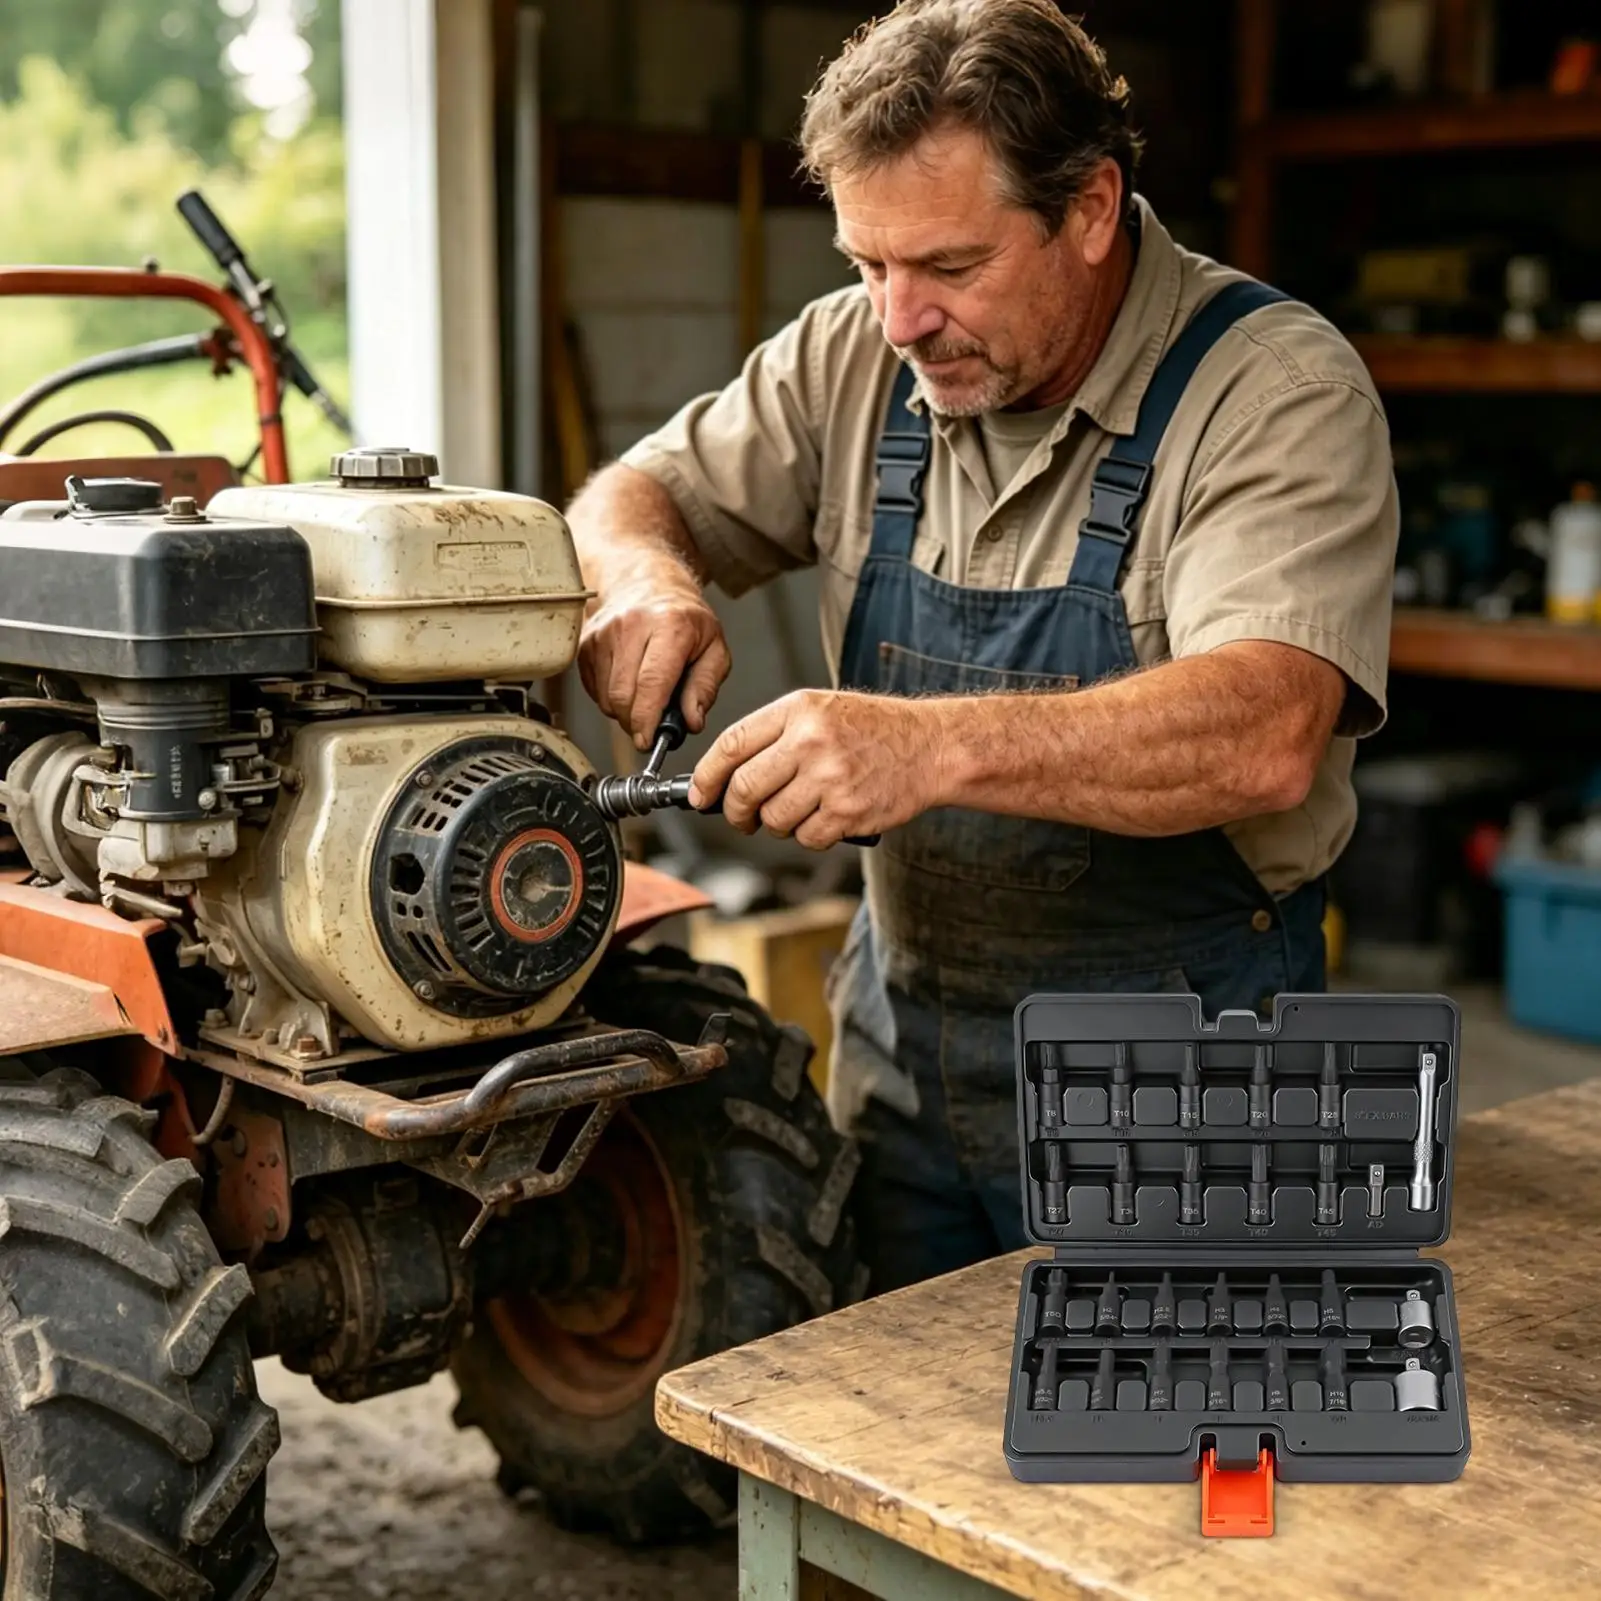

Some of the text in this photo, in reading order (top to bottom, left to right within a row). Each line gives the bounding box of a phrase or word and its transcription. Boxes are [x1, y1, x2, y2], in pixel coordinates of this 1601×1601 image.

[1113, 1109, 1130, 1118] T10
[1181, 1110, 1198, 1119] T15
[1250, 1110, 1268, 1119] T20
[1046, 1206, 1064, 1215] T27
[1250, 1207, 1267, 1216] T40
[1318, 1207, 1336, 1216] T45
